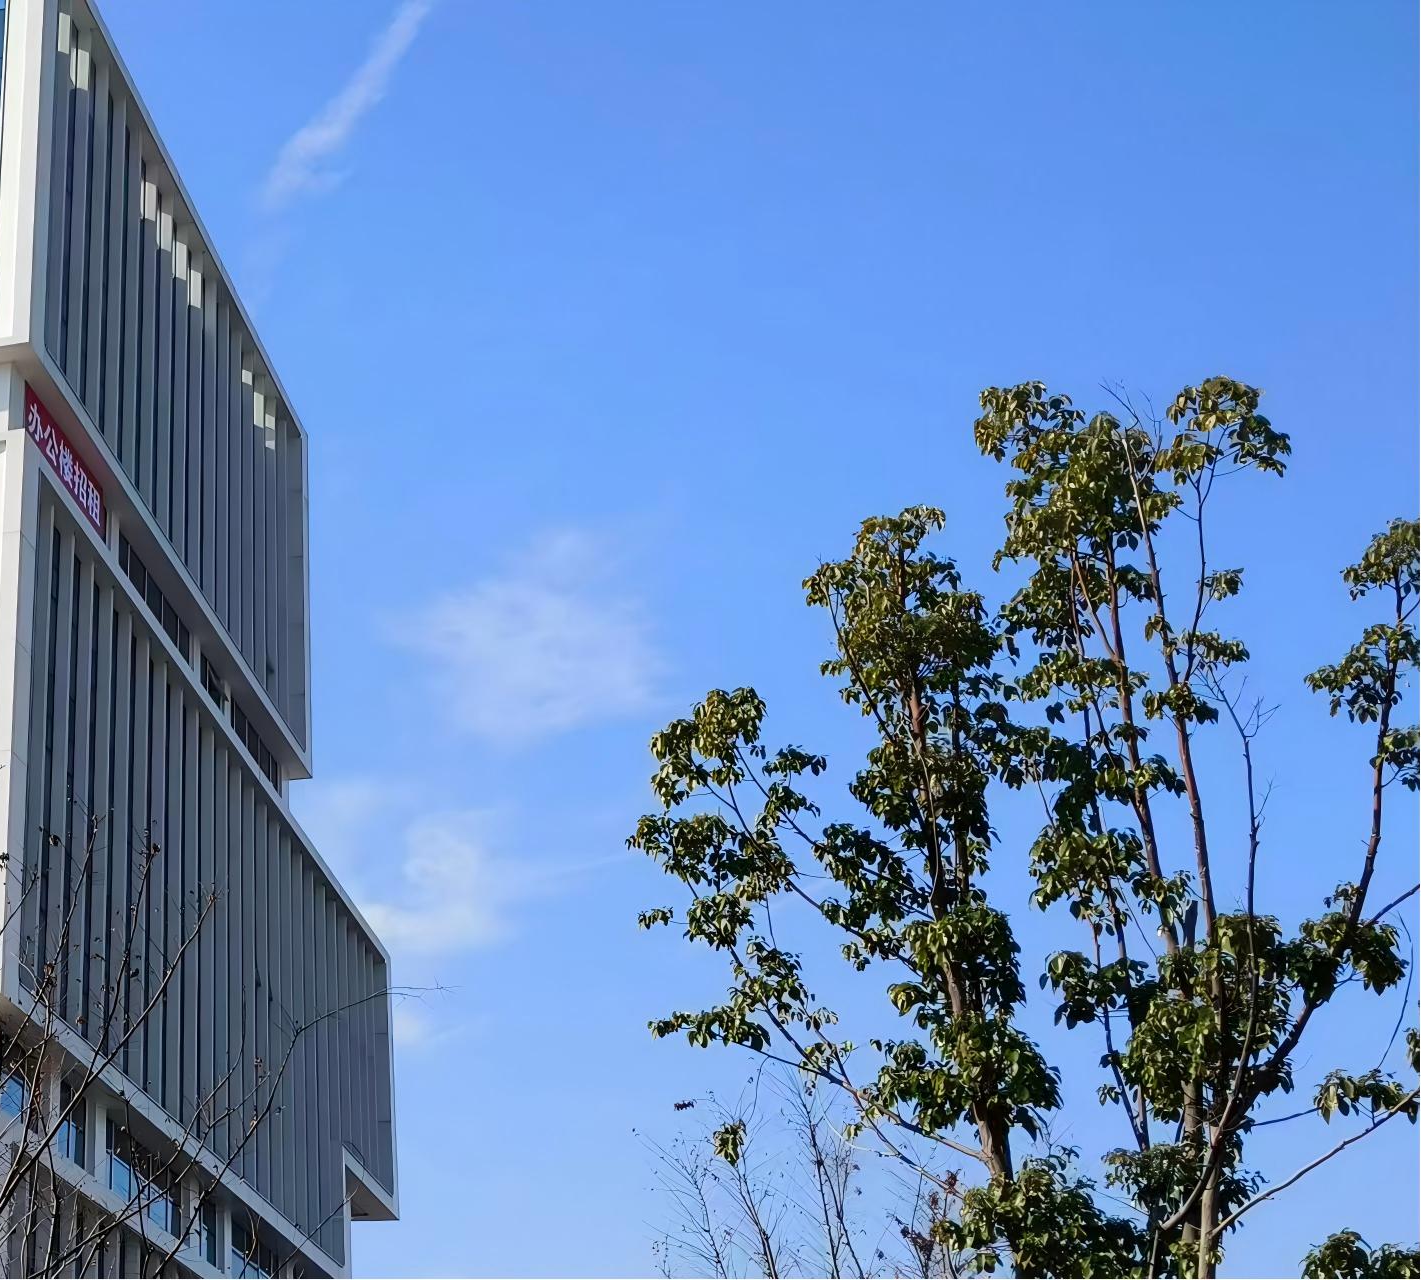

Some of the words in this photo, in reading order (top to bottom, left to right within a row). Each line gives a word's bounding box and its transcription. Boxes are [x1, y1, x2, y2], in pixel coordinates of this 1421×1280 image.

[27, 402, 101, 527] 办公楼招租
